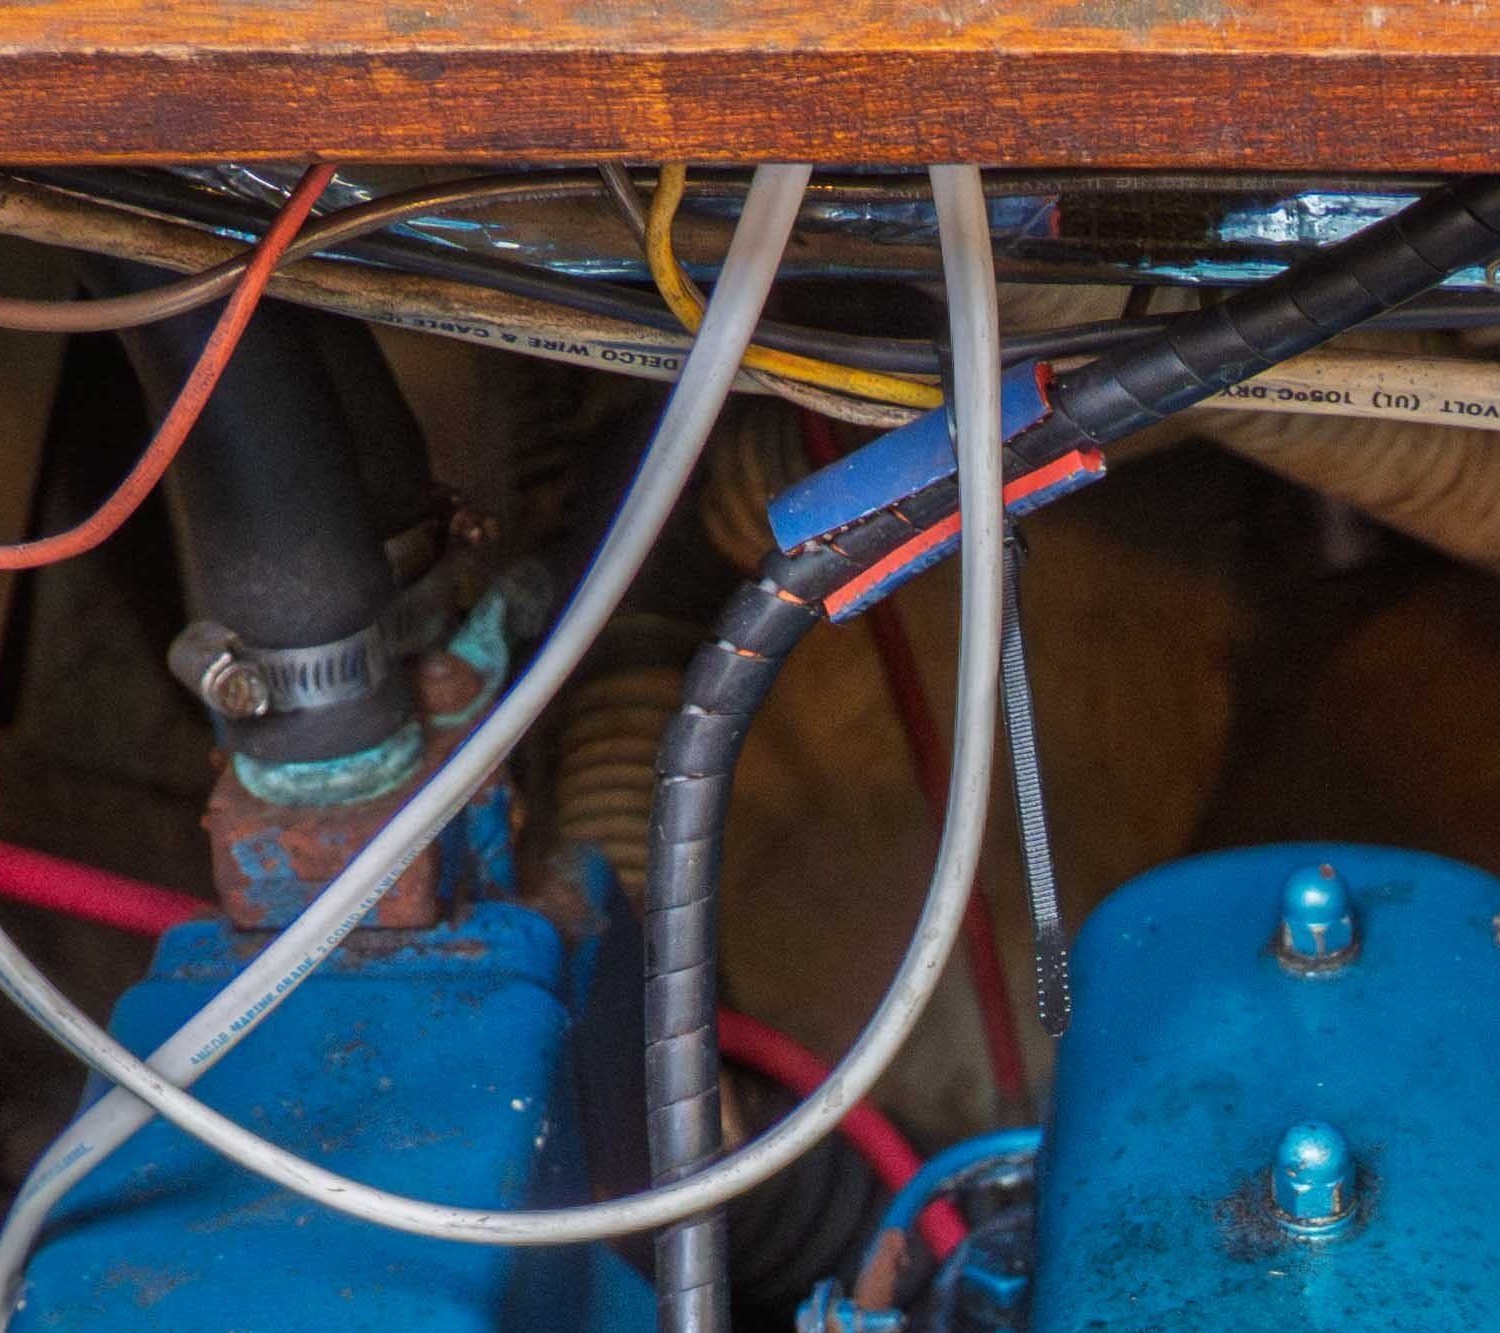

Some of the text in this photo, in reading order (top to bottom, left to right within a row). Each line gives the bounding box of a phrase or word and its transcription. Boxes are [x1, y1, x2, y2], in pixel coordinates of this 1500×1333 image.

[501, 333, 519, 344] &
[529, 336, 591, 356] WIRE
[601, 349, 679, 371] DELCO
[1372, 391, 1420, 411] (UL)
[1441, 401, 1500, 418] VOLT
[229, 992, 275, 1033] MARINE
